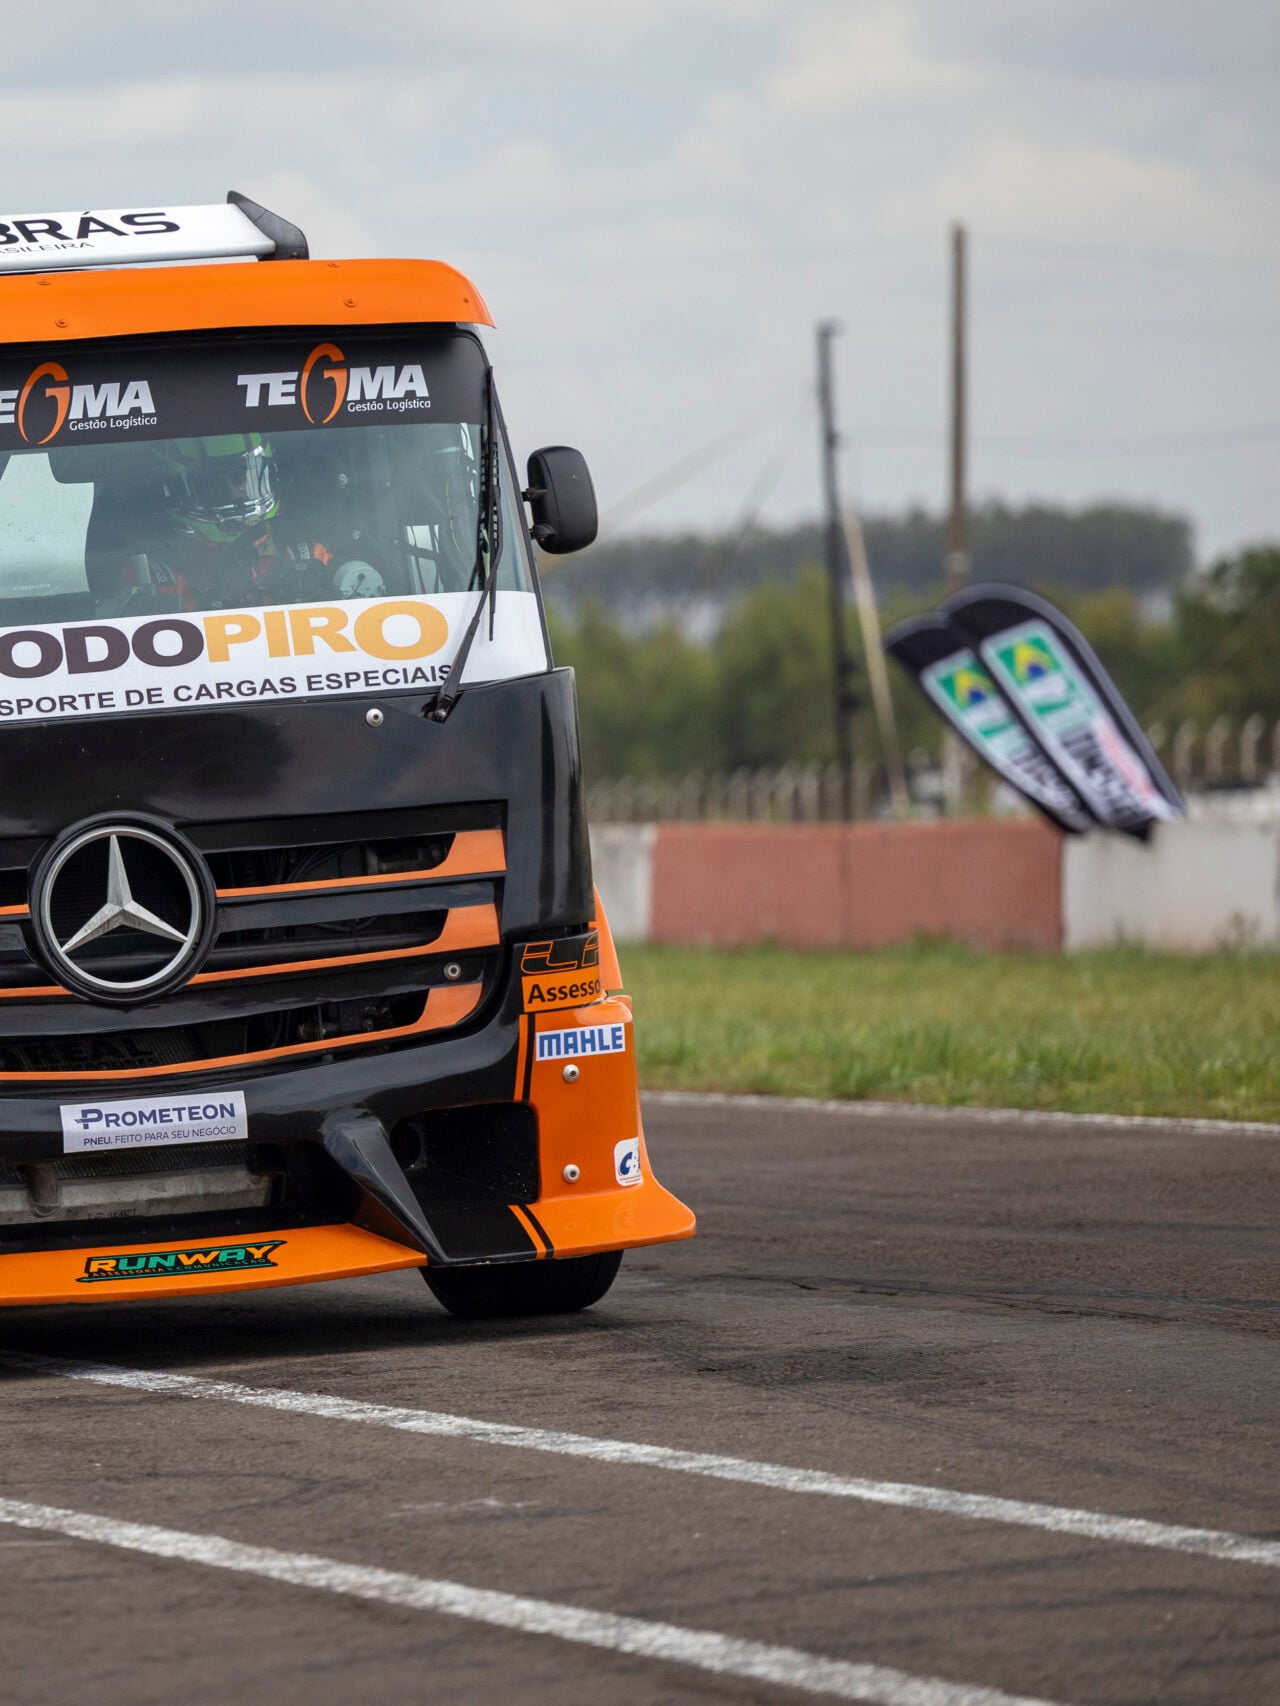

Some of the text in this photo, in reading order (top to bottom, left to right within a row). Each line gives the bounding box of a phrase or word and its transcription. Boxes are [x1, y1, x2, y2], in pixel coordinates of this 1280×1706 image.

[237, 343, 429, 424] TEGMA
[348, 398, 431, 413] Gestão Logística
[70, 415, 157, 431] Gestão Logística
[125, 687, 165, 707] DE
[173, 676, 297, 701] CARGAS
[306, 664, 453, 692] ESPECIAIS
[539, 1026, 623, 1058] MAHLE
[77, 1103, 236, 1130] PROMETEON
[83, 1126, 236, 1147] PNEU. FEITO PARA SEU NEGÓCIO
[89, 1245, 273, 1273] RUNWAY
[93, 1267, 165, 1278] ASSESSORIA
